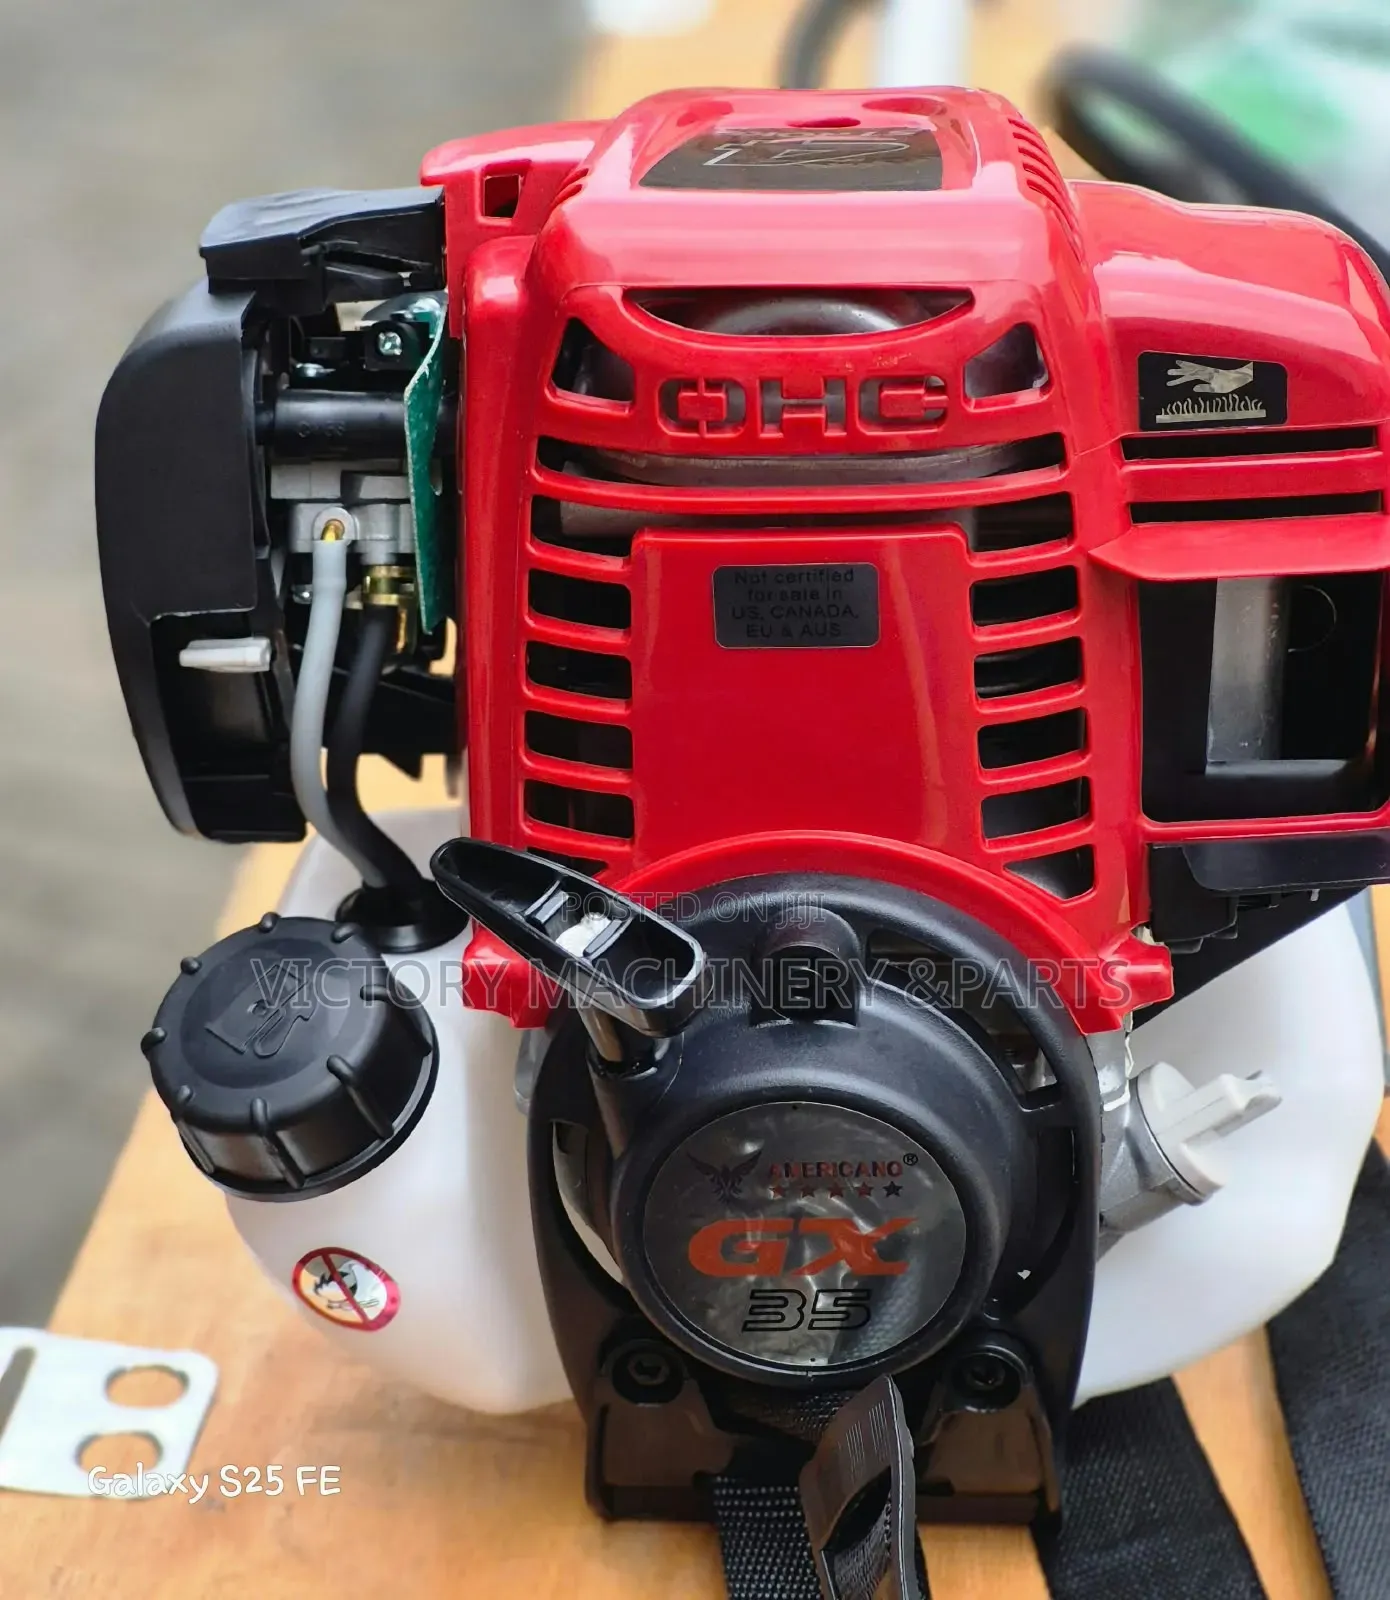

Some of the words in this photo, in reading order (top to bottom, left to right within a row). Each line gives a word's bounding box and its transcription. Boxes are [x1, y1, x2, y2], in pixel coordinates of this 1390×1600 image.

[656, 374, 949, 437] OHC
[734, 570, 767, 584] Not
[773, 568, 855, 584] certified
[748, 588, 773, 602] for
[779, 588, 820, 602] sale
[826, 587, 843, 602] in
[746, 623, 773, 639] EU
[781, 623, 794, 638] &
[800, 622, 842, 638] AUS
[688, 1217, 919, 1277] GX
[741, 1288, 872, 1332] 35
